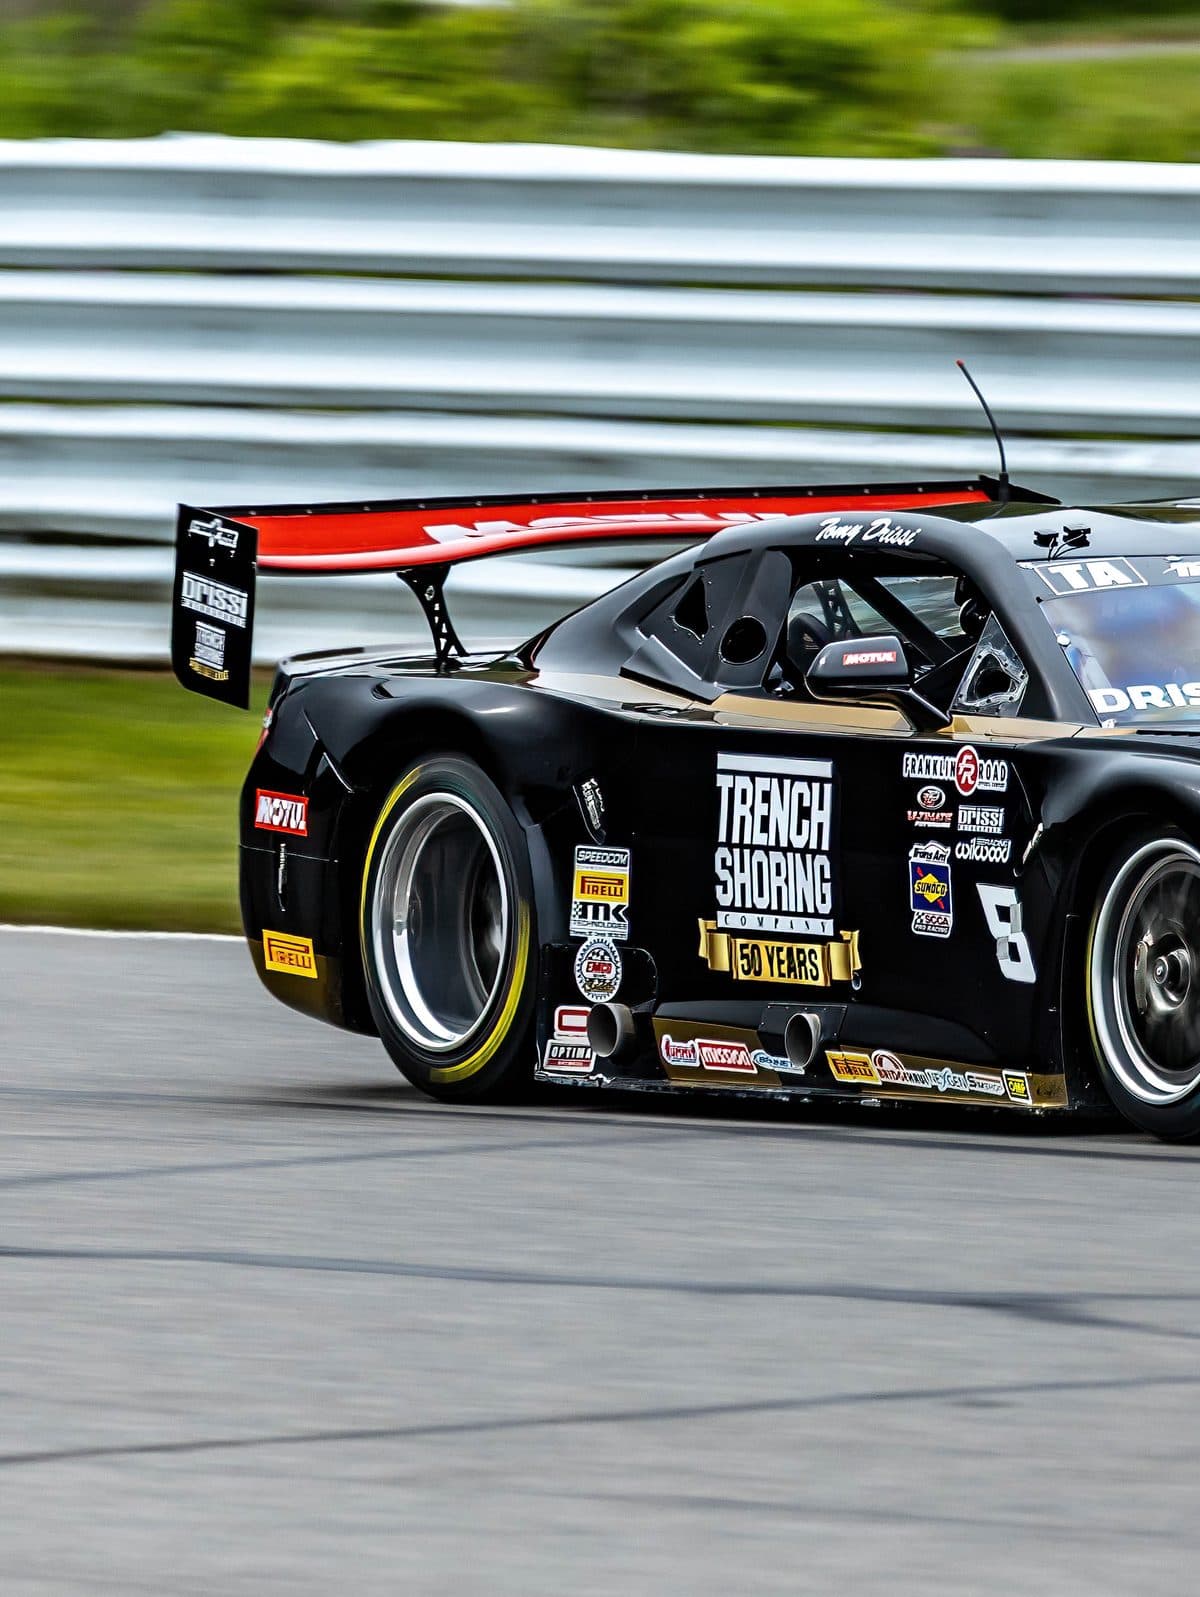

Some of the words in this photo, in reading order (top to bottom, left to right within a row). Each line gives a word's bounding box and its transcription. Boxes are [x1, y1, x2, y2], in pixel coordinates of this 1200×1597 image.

[862, 517, 921, 546] Drissi
[1048, 561, 1132, 589] TA
[903, 755, 956, 779] FRANKLIN
[978, 761, 1007, 783] ROAD
[257, 795, 307, 831] MOTUL
[716, 773, 832, 850] TRENCH
[580, 876, 624, 897] PIRELLI
[715, 847, 832, 914] SHORING
[915, 881, 946, 895] SUNOCO
[924, 914, 949, 926] SCCA
[976, 883, 1036, 983] 8
[739, 943, 763, 977] 50
[766, 945, 820, 982] YEARS
[551, 1046, 592, 1060] OPTIMA
